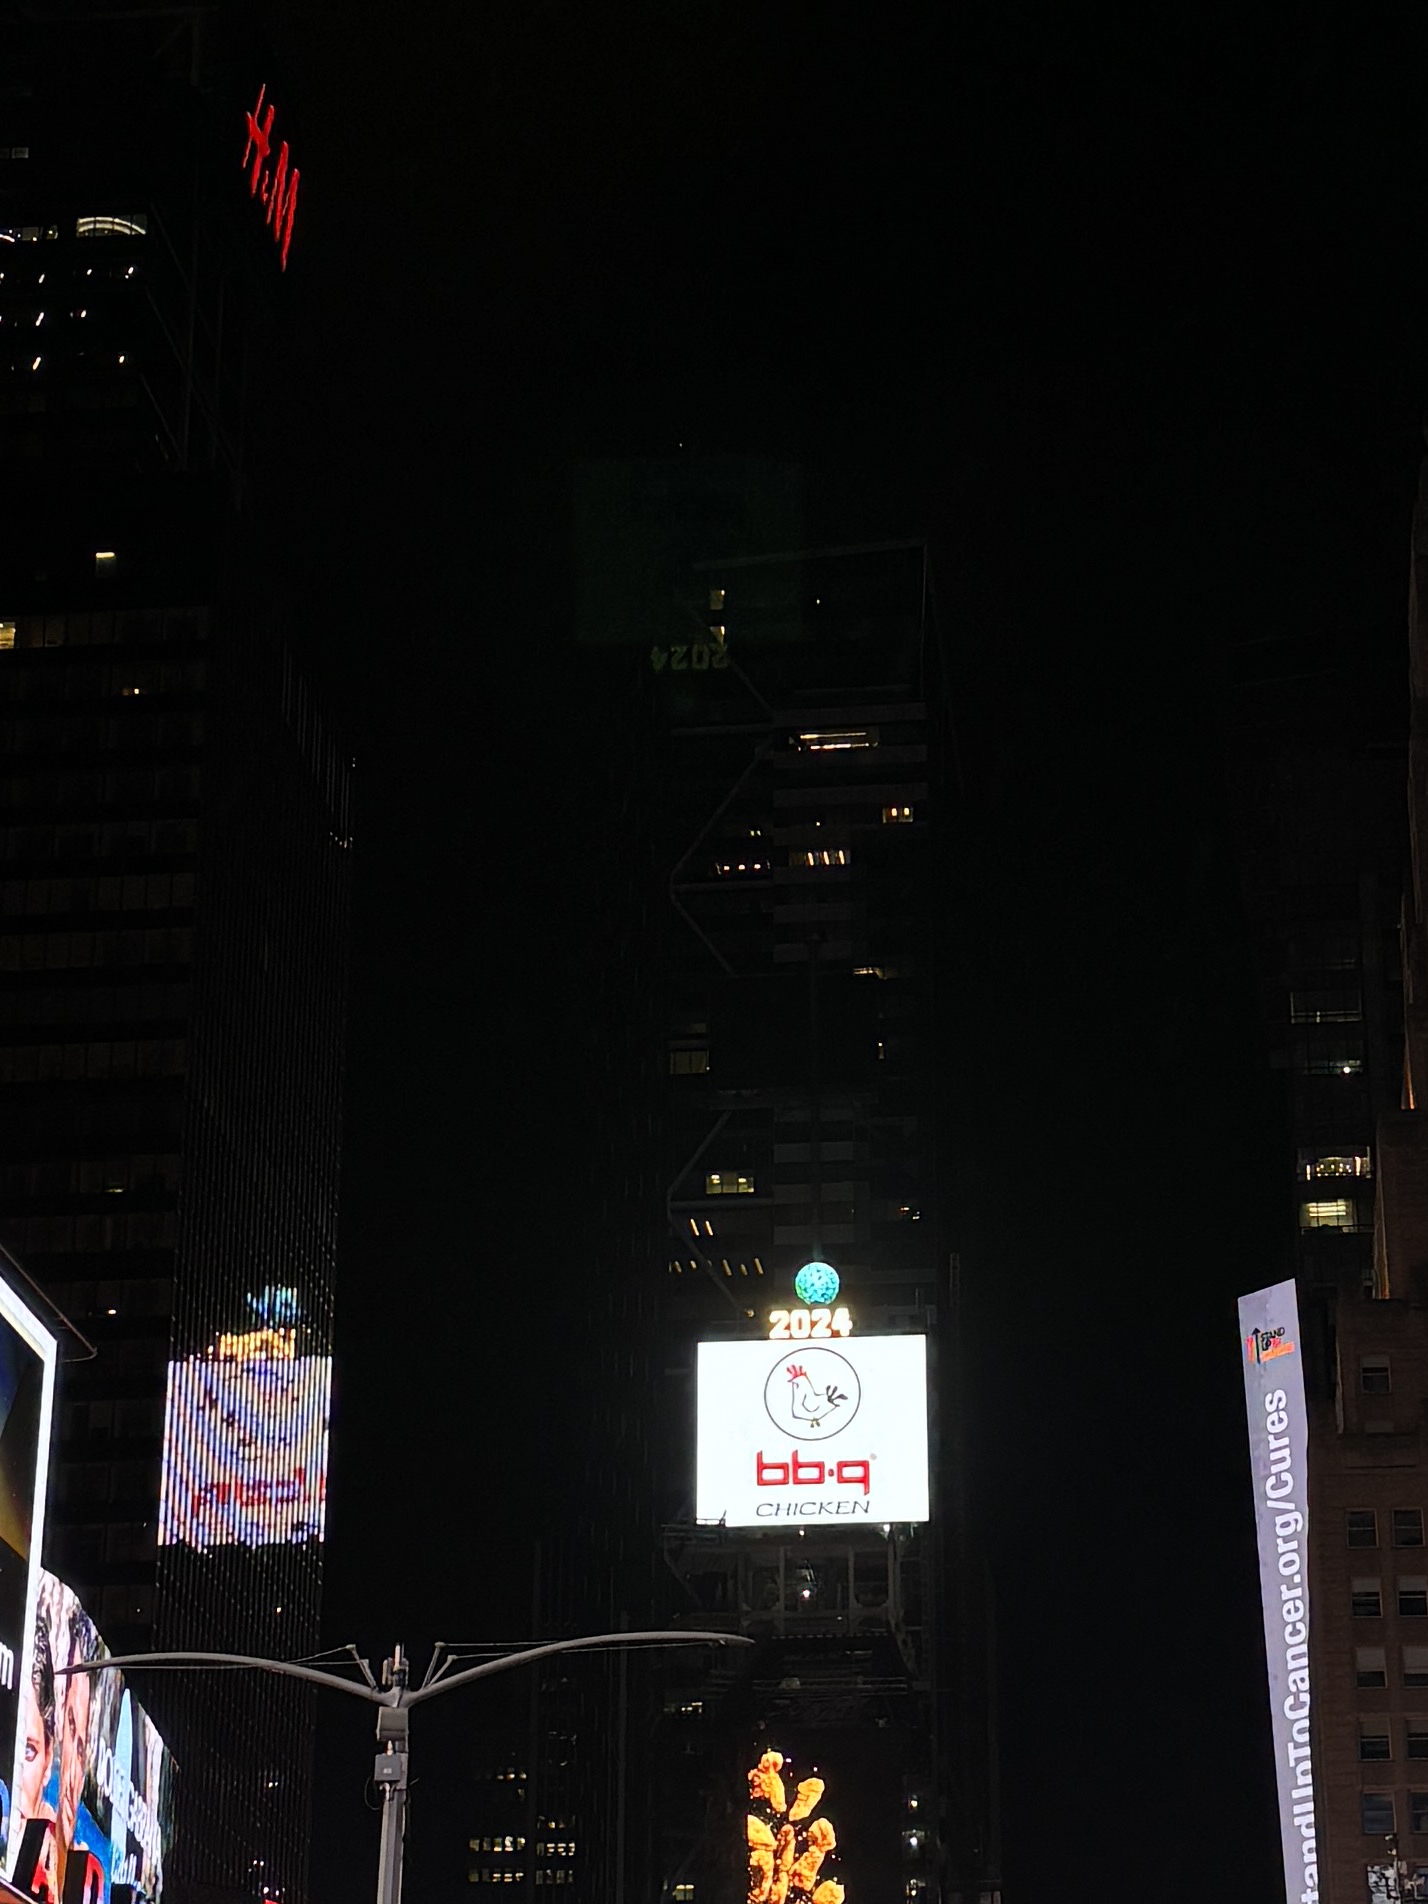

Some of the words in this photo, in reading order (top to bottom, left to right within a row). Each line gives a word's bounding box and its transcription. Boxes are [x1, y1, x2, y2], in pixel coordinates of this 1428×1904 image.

[242, 83, 300, 273] H&M
[769, 1307, 853, 1340] 2024
[755, 1500, 871, 1518] CHICKEN
